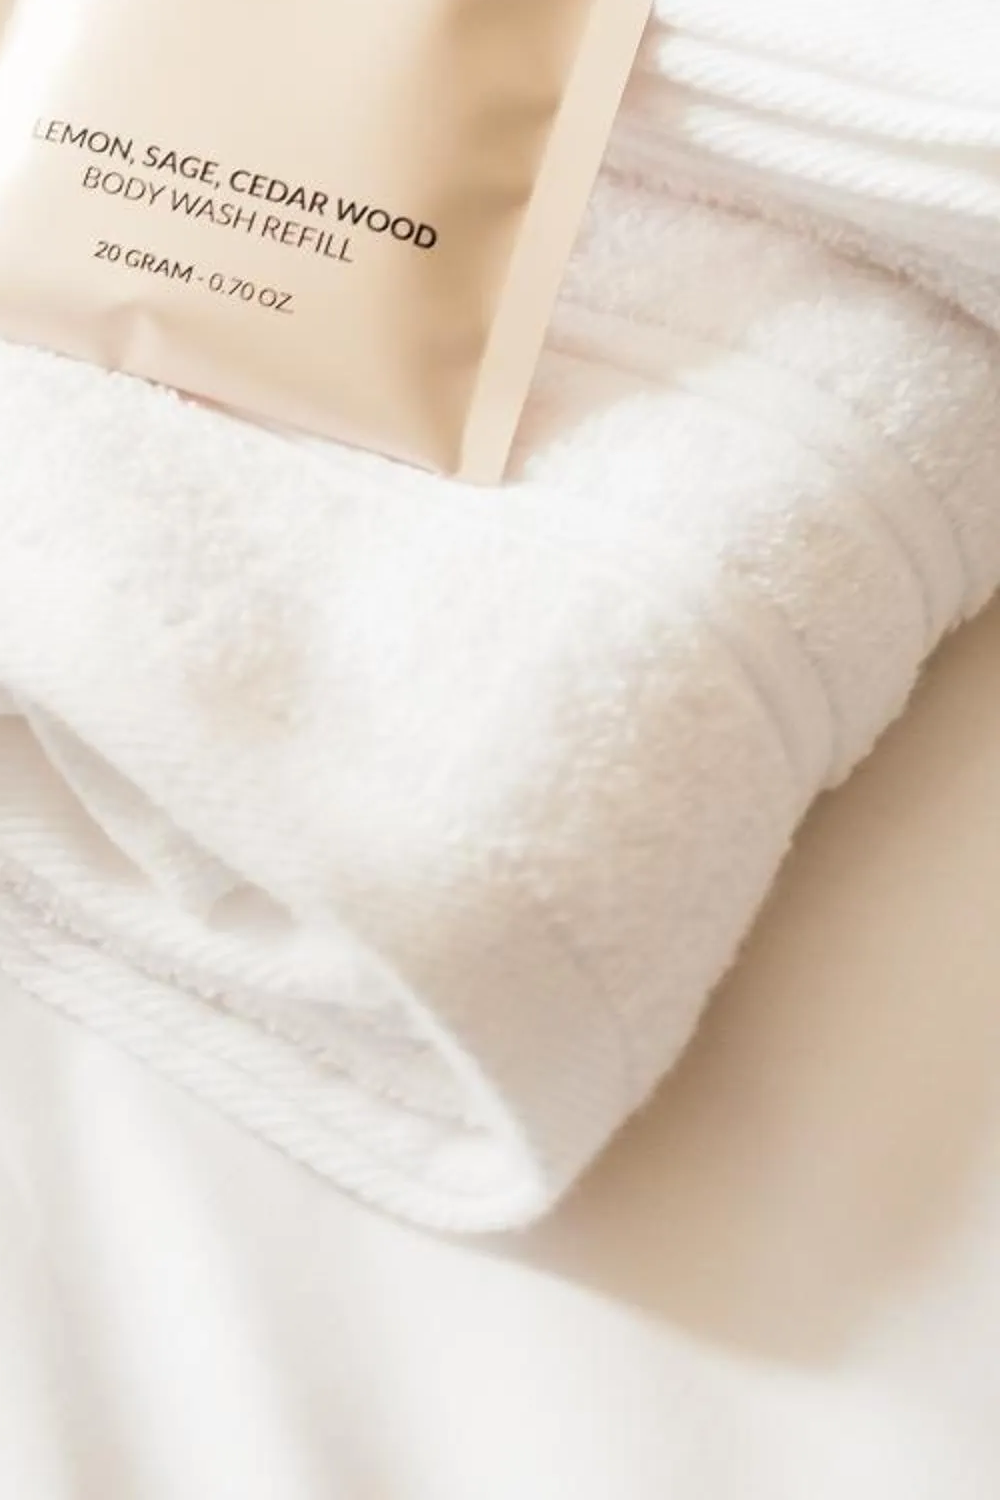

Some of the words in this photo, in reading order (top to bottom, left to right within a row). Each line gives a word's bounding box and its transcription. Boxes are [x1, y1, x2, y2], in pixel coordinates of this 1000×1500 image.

[32, 117, 135, 166] LEMON,
[141, 144, 221, 189] SAGE,
[228, 168, 331, 217] CEDAR
[336, 198, 439, 251] WOOD
[82, 165, 166, 206] BODY
[169, 188, 259, 234] WASH
[261, 215, 355, 264] REFILL
[94, 240, 121, 263] 20
[124, 248, 195, 284] GRAM
[208, 272, 255, 301] 0.70
